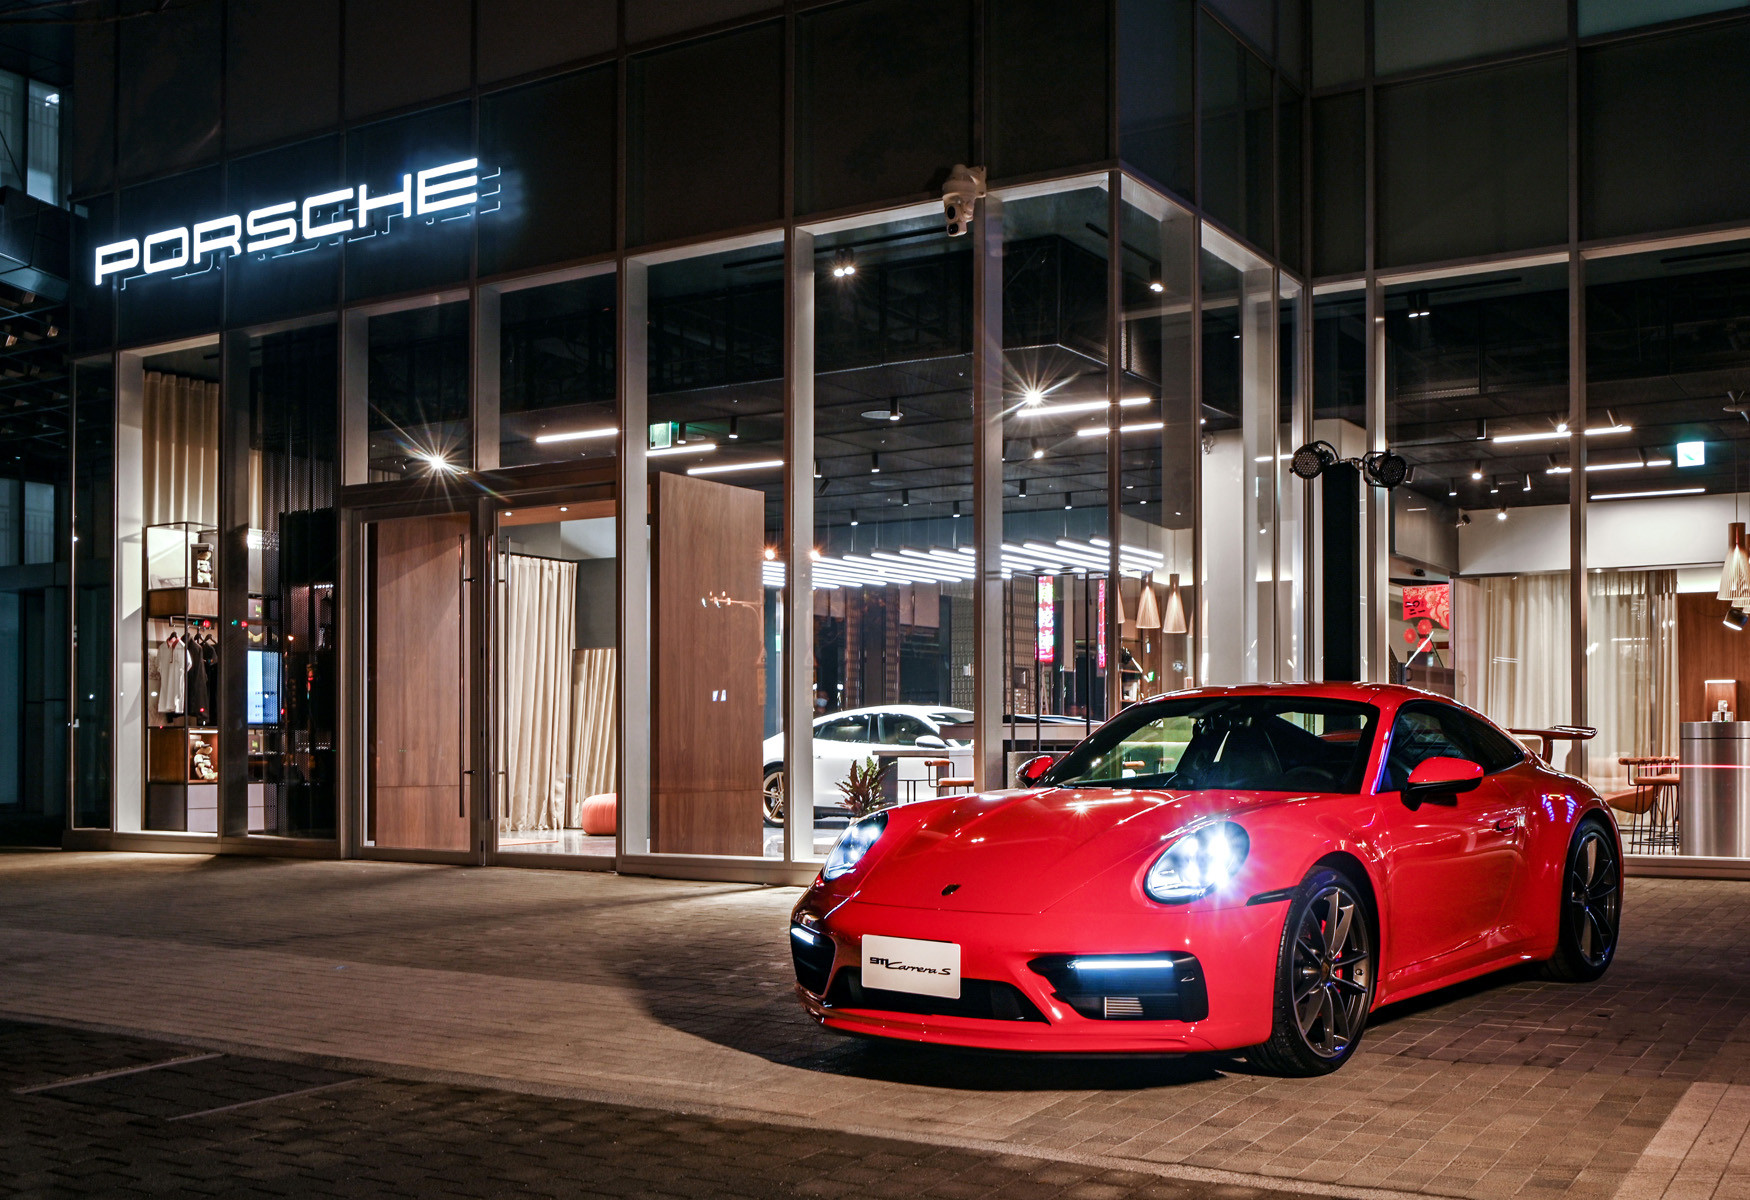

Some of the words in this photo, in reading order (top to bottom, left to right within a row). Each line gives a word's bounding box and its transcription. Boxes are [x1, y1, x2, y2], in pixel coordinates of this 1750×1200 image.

[94, 157, 478, 286] PORSCHE
[869, 956, 889, 965] 911
[885, 961, 937, 974] Carrera
[938, 968, 952, 976] S
